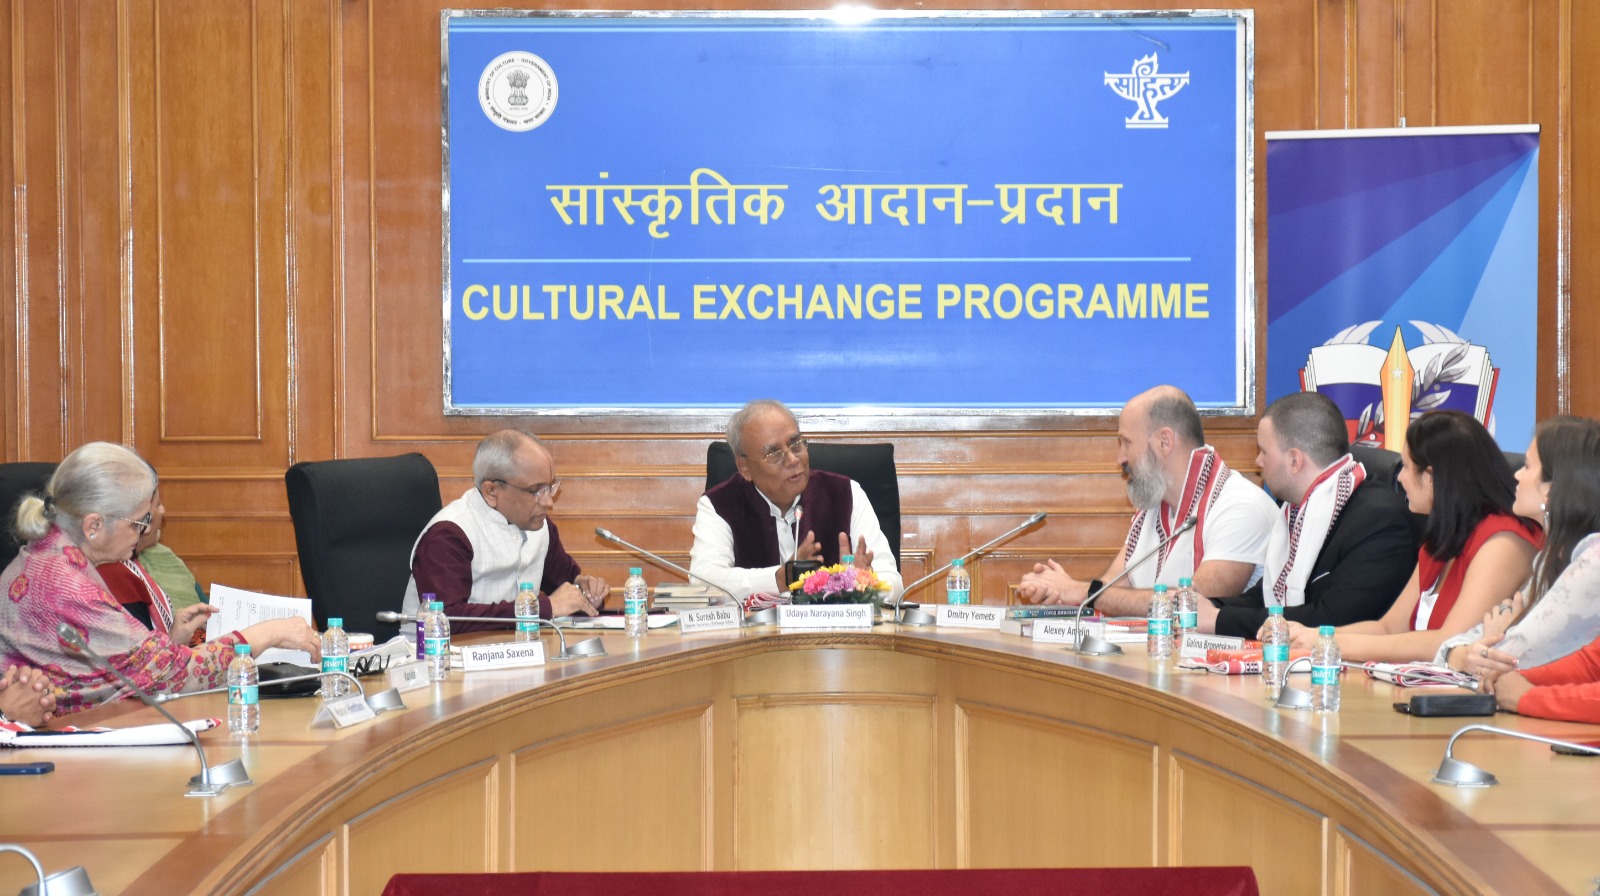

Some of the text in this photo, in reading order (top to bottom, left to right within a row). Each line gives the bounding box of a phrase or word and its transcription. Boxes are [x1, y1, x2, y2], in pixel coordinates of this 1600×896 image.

[494, 58, 515, 72] CULTURE
[520, 57, 549, 79] GOVERNMENT
[546, 169, 1123, 239] सांस्कृतिक आदान-प्रदान
[463, 283, 1209, 320] CULTURAL EXCHANGE PROGRAMME
[688, 610, 731, 623] N. Suresh Babu
[786, 607, 866, 620] Udaya Narayana Singh
[947, 609, 995, 621] Dmitry Yemets
[1043, 624, 1066, 636] Alexey
[1186, 637, 1203, 649] Galina
[472, 648, 534, 662] Ranjana Saxena
[323, 660, 343, 668] Bisleri
